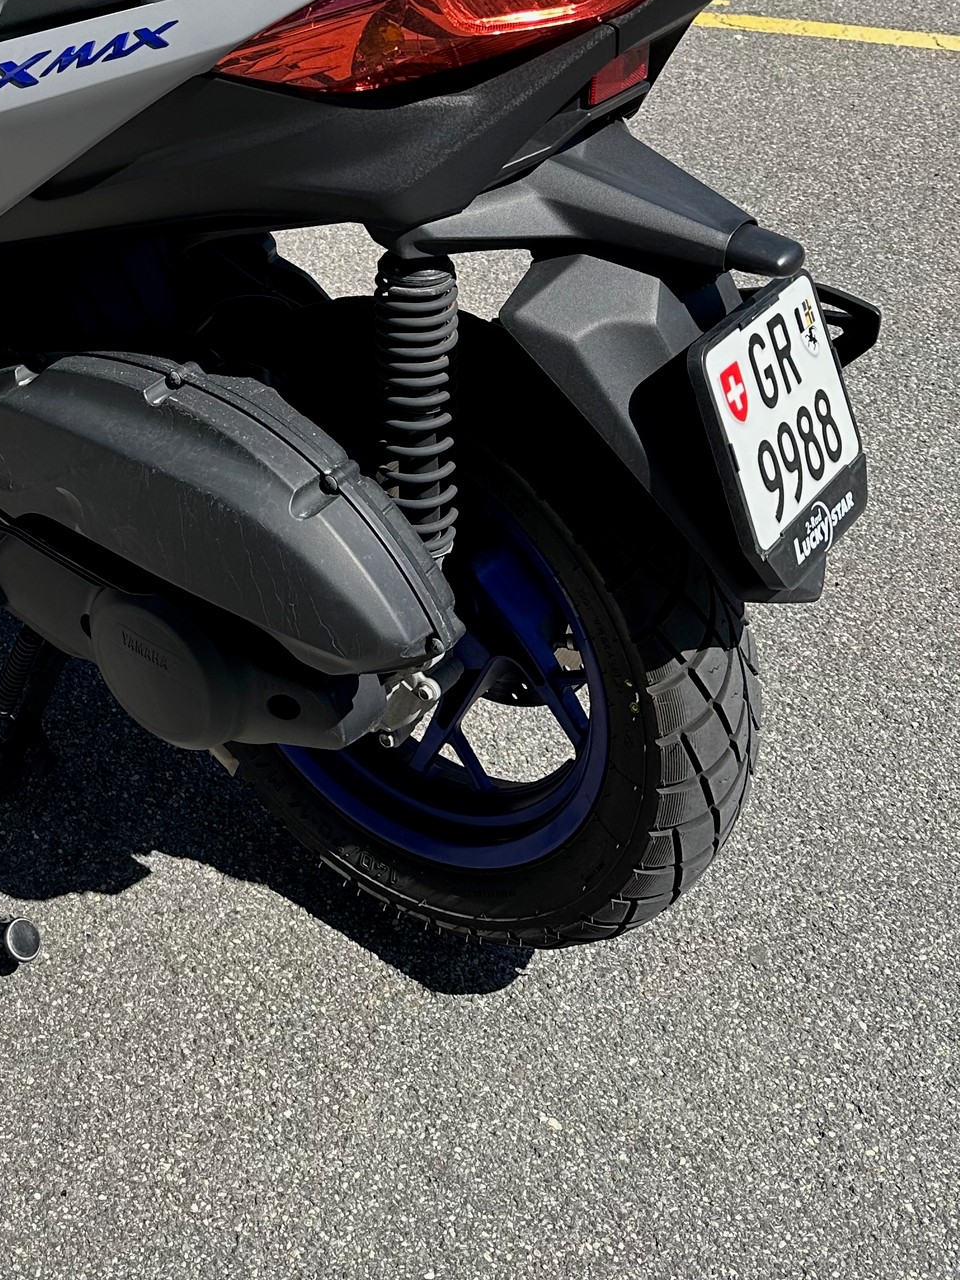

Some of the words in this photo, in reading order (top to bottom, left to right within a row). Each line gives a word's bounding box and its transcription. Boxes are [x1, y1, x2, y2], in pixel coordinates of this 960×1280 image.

[748, 312, 802, 409] GR
[757, 388, 843, 523] 9988
[831, 491, 855, 527] STAR
[122, 631, 168, 671] YAMAHA
